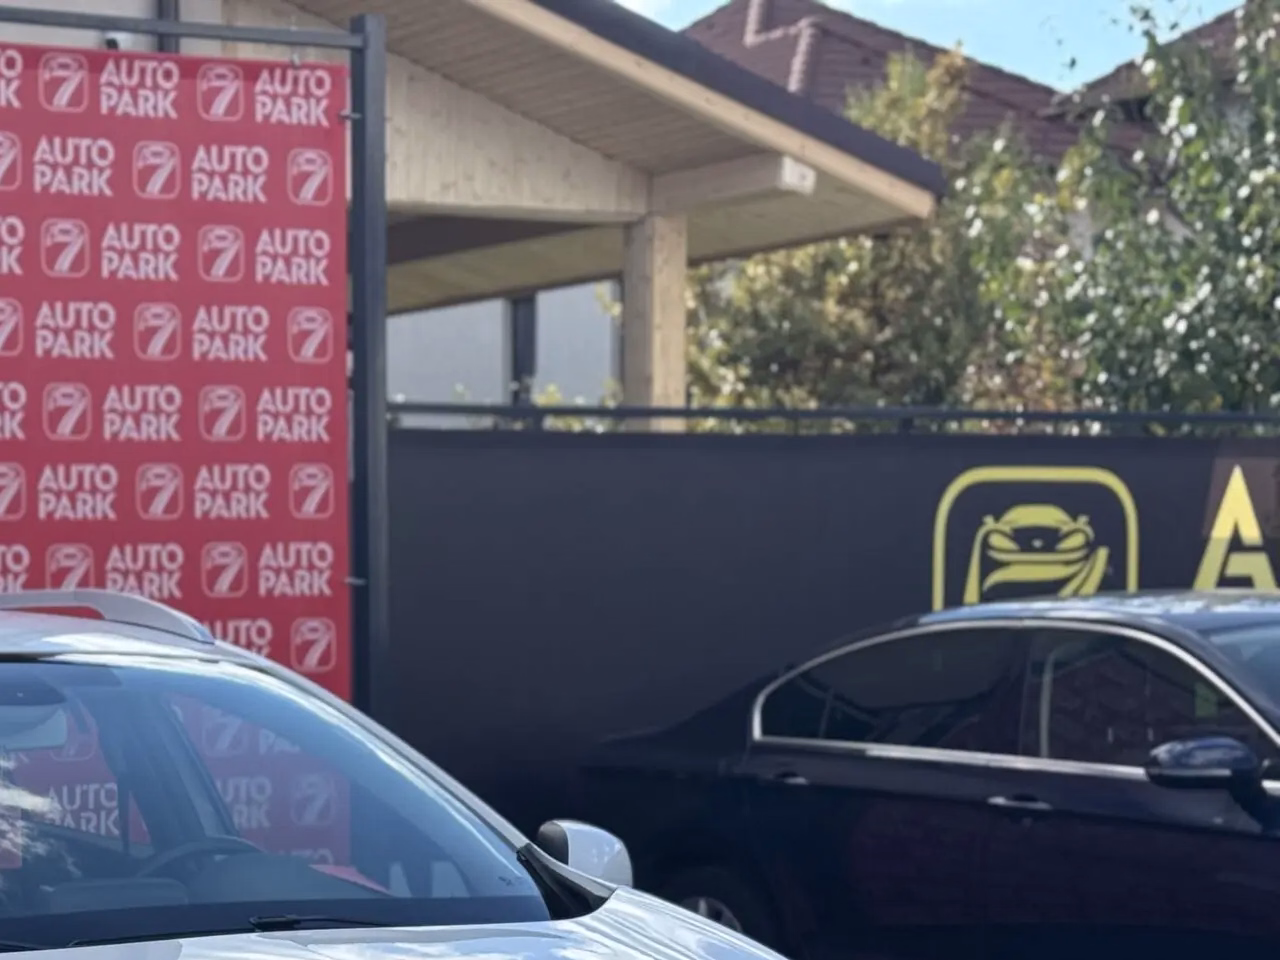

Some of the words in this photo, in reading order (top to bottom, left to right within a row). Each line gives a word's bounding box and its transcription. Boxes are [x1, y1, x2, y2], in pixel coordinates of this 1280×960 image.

[100, 58, 179, 89] AUTO
[254, 68, 331, 97] AUTO
[100, 88, 178, 119] PARK
[254, 97, 329, 127] PARK
[34, 136, 114, 168] AUTO
[192, 145, 269, 174] AUTO
[34, 165, 113, 196] PARK
[192, 174, 266, 203] PARK
[102, 223, 180, 251] AUTO
[256, 229, 330, 257] AUTO
[102, 251, 178, 281] PARK
[256, 257, 328, 285] PARK
[36, 302, 115, 330] AUTO
[193, 306, 269, 332] AUTO
[36, 329, 114, 359] PARK
[193, 331, 268, 362] PARK
[103, 385, 182, 413] AUTO
[257, 387, 331, 414] AUTO
[104, 412, 181, 442] PARK
[257, 414, 330, 442] PARK
[38, 464, 118, 492] AUTO
[194, 464, 270, 492] AUTO
[38, 492, 116, 520] PARK
[195, 492, 269, 519] PARK
[105, 543, 184, 572] AUTO
[259, 543, 333, 570] AUTO
[259, 570, 332, 597] PARK
